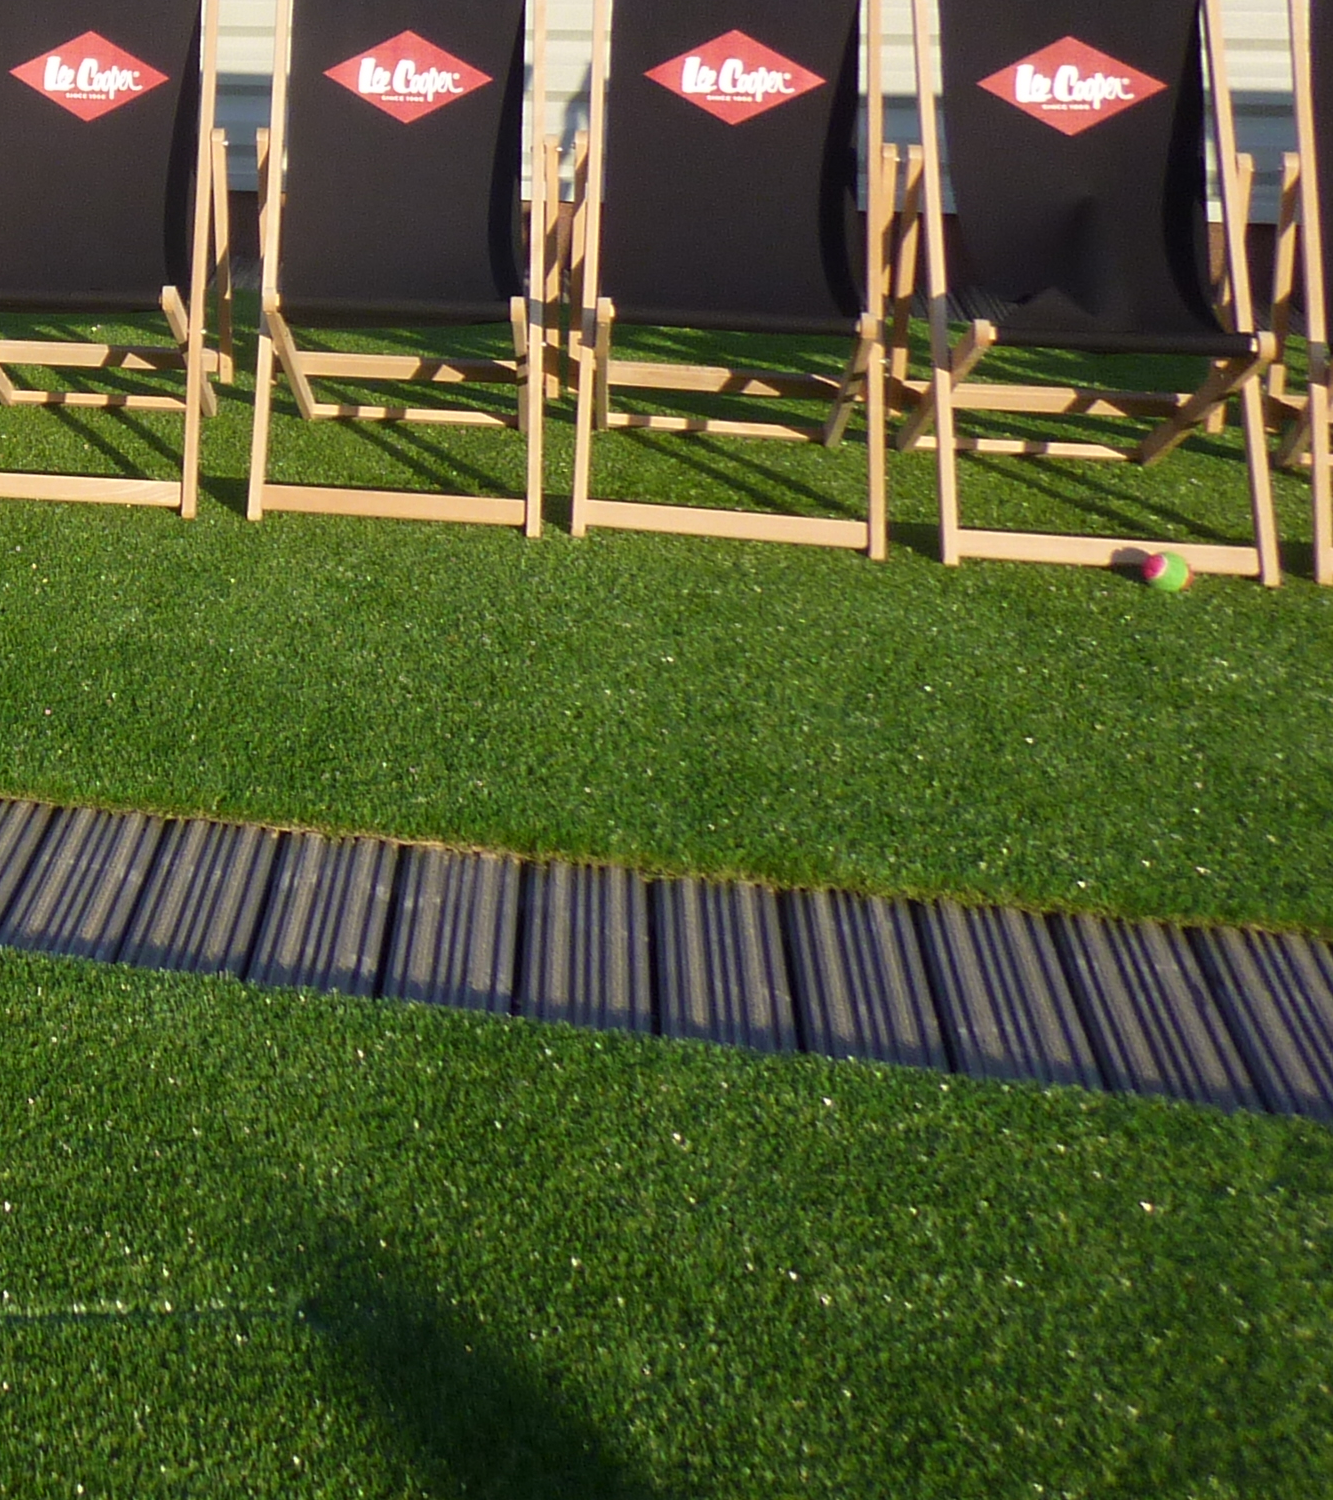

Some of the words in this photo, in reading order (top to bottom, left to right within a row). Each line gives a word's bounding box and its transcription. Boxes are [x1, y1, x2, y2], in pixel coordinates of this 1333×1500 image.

[76, 58, 143, 100] Cooper
[392, 59, 464, 102] Cooper
[718, 58, 795, 102] Cooper
[1053, 65, 1135, 110] Cooper
